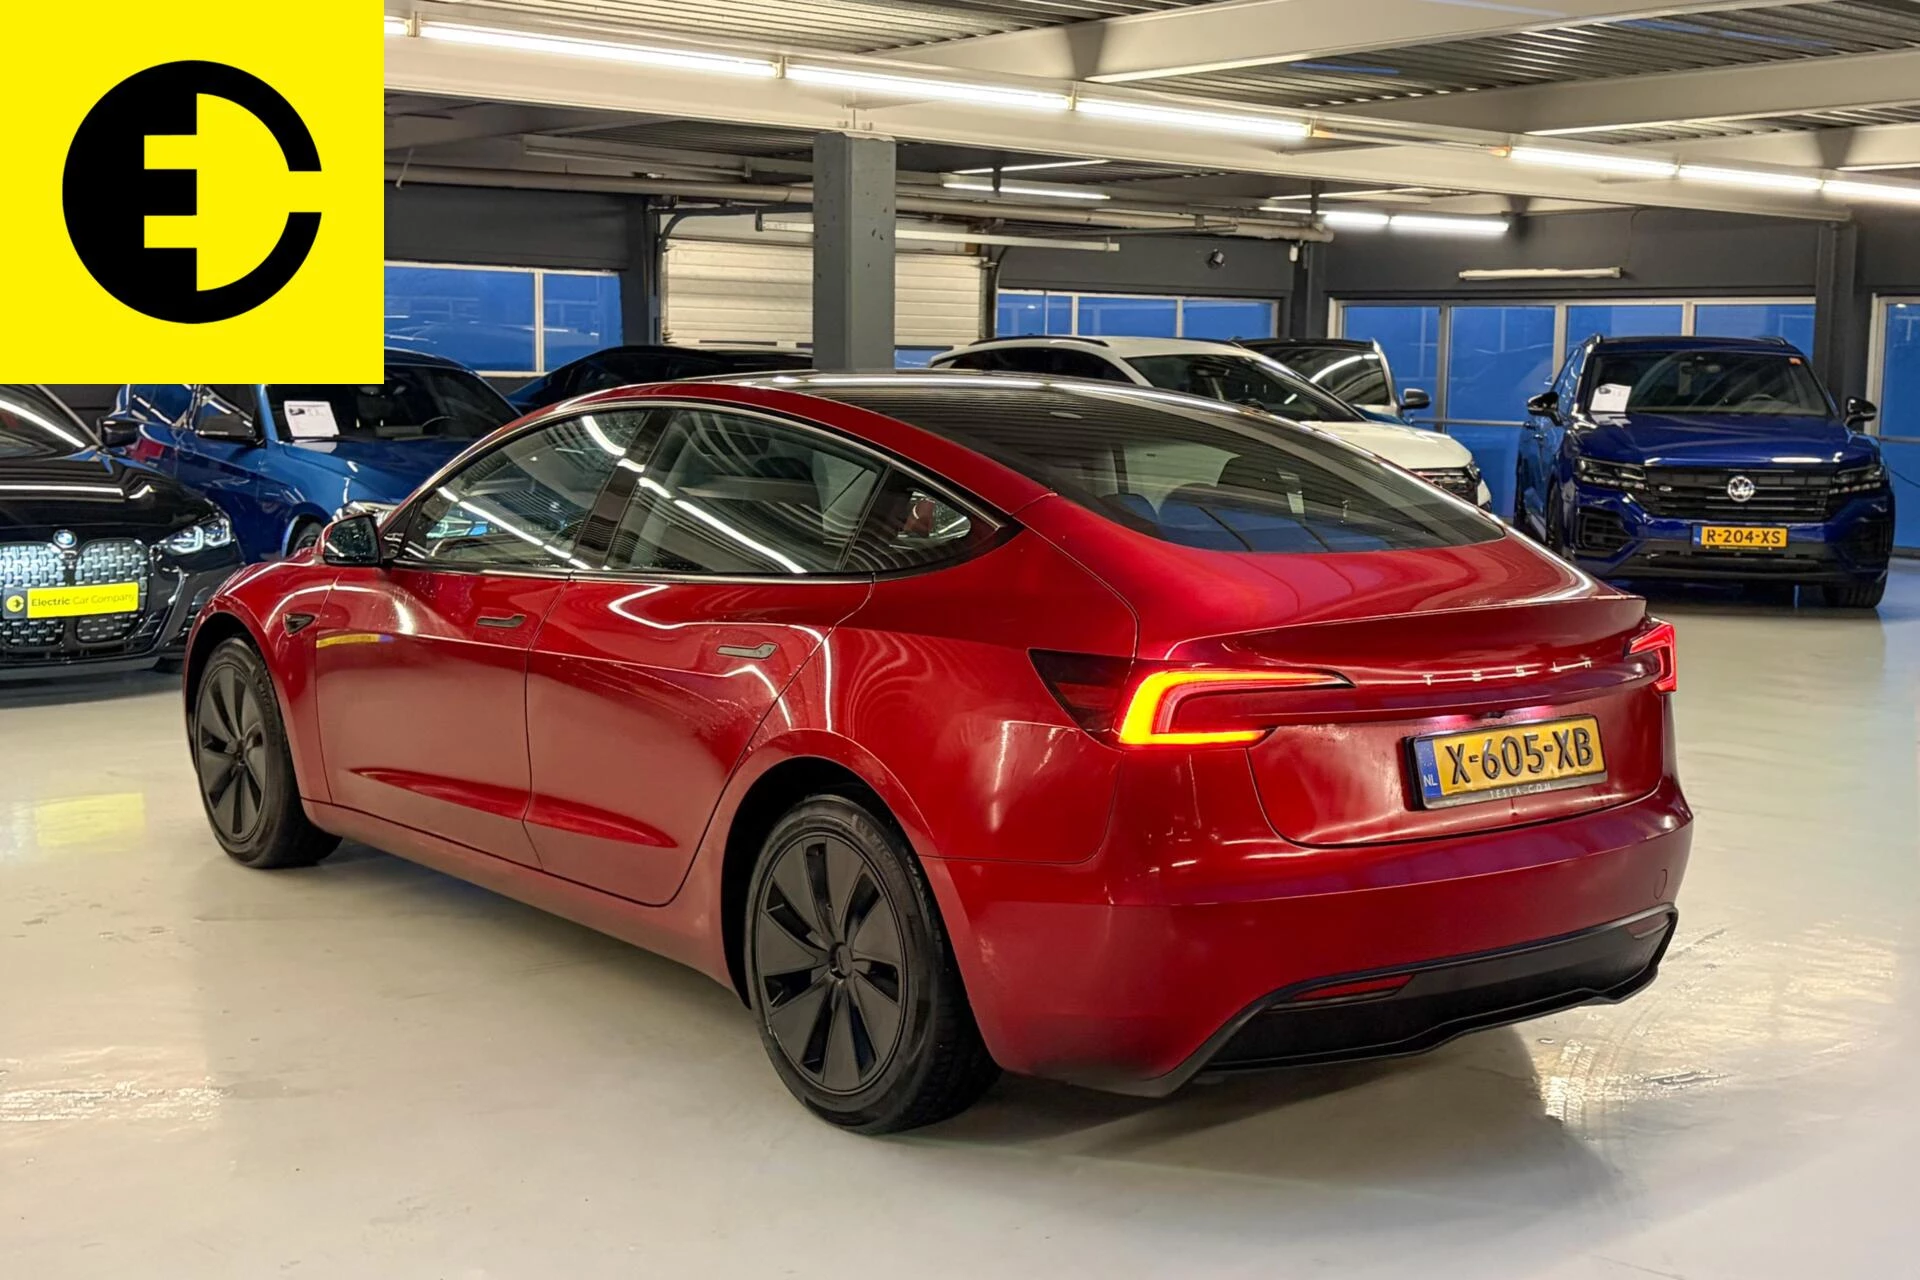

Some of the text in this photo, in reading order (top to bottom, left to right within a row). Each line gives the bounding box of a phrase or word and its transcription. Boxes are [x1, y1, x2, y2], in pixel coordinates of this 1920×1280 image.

[1706, 528, 1781, 545] R-204-XS
[31, 596, 70, 607] Electric
[72, 596, 89, 605] Car
[91, 593, 135, 604] Company
[1423, 658, 1592, 685] TESLA
[1444, 727, 1594, 785] X-605-XB
[1423, 773, 1439, 787] NL
